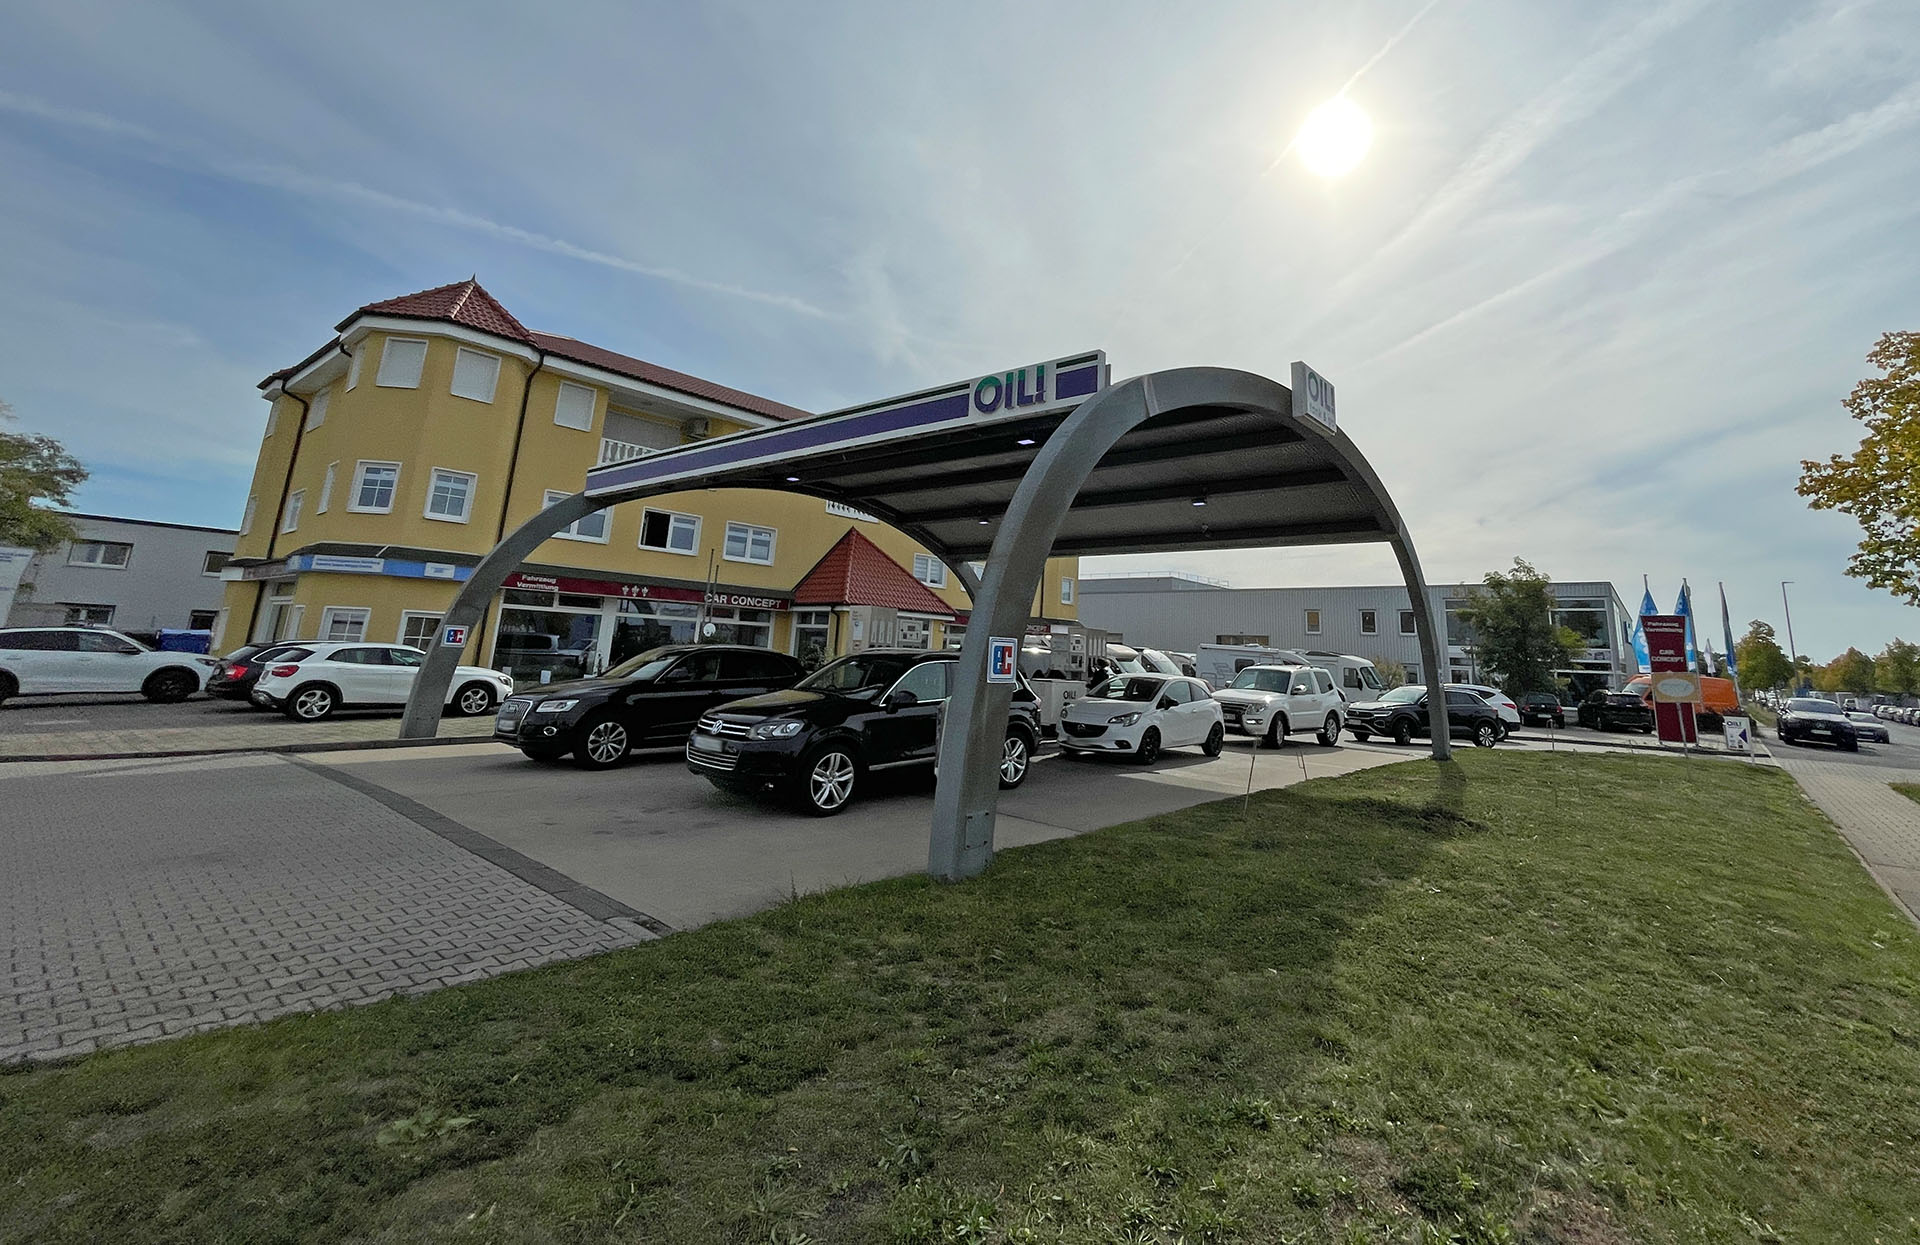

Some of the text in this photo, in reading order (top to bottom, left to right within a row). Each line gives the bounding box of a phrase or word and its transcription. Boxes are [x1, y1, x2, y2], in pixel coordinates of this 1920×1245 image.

[521, 574, 557, 584] Fahrzeug
[516, 581, 559, 592] Vermittlung
[704, 593, 781, 609] CAR CONCEPT
